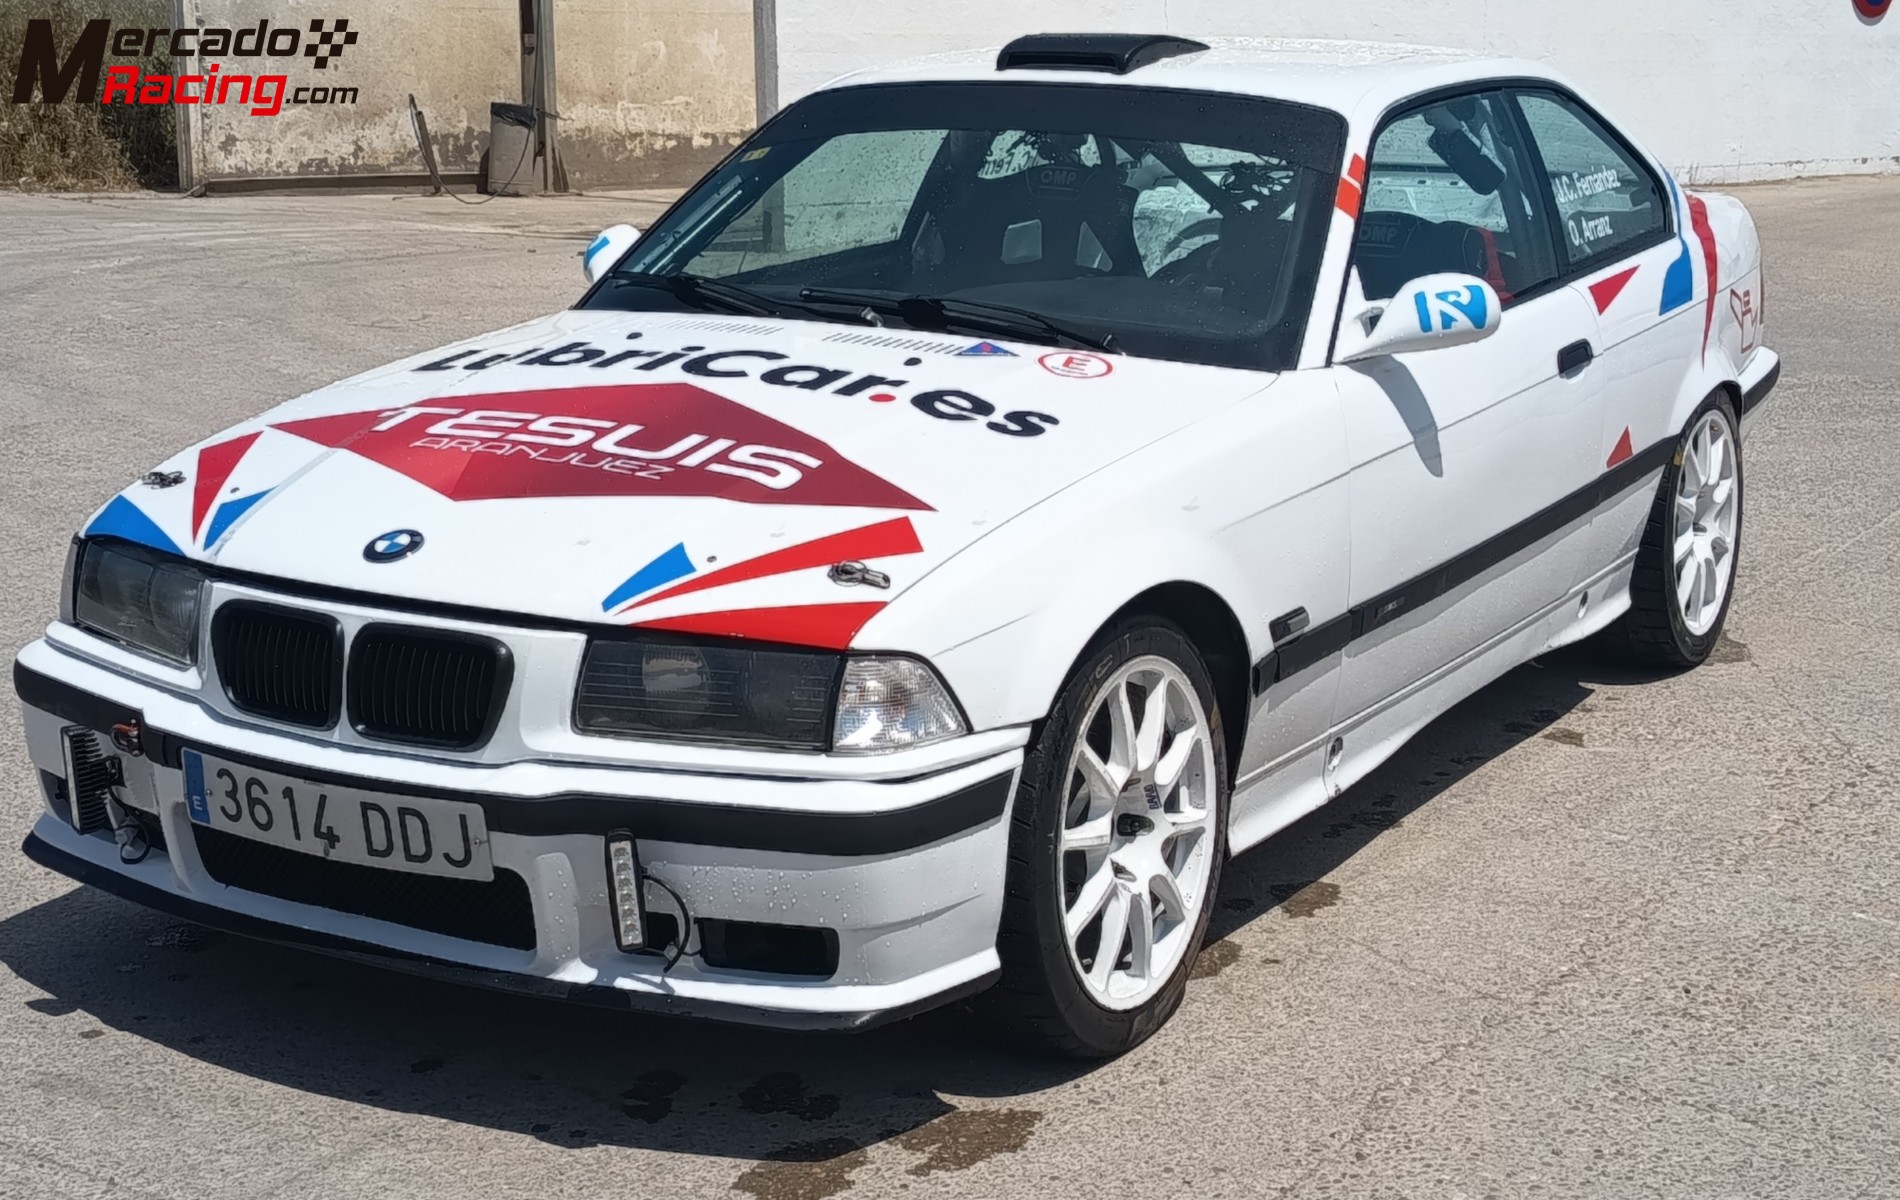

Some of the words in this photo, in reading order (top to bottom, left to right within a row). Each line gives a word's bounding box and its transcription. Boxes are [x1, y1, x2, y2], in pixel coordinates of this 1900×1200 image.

[1040, 169, 1077, 185] OMP
[1555, 174, 1578, 203] J.C.
[1568, 219, 1584, 247] O.
[1581, 215, 1613, 243] Arranz
[1062, 355, 1092, 372] E
[410, 341, 1060, 436] LubriCar.es
[370, 406, 824, 491] TESUIS
[409, 436, 676, 481] ARANJUEZ
[216, 767, 341, 850] 3614
[360, 800, 474, 869] DDJ
